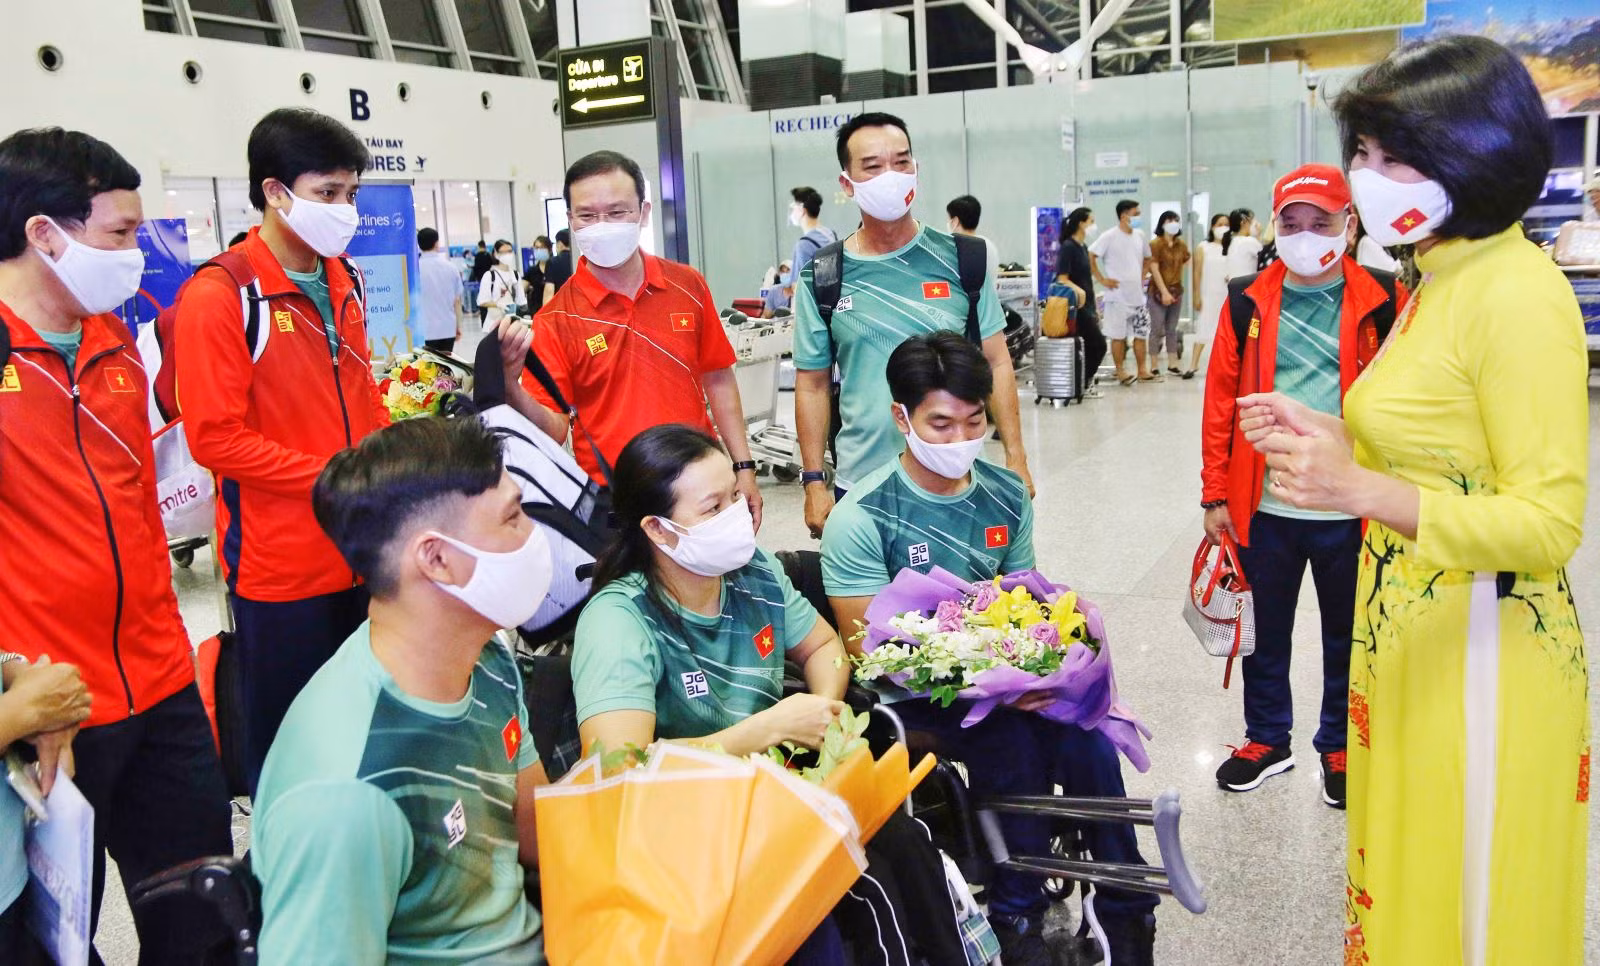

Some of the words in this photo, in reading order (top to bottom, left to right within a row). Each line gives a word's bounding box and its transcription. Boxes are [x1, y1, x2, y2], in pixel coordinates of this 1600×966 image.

[568, 74, 619, 92] Departure
[349, 88, 371, 121] B
[385, 139, 404, 149] BAY
[159, 484, 198, 515] mitre
